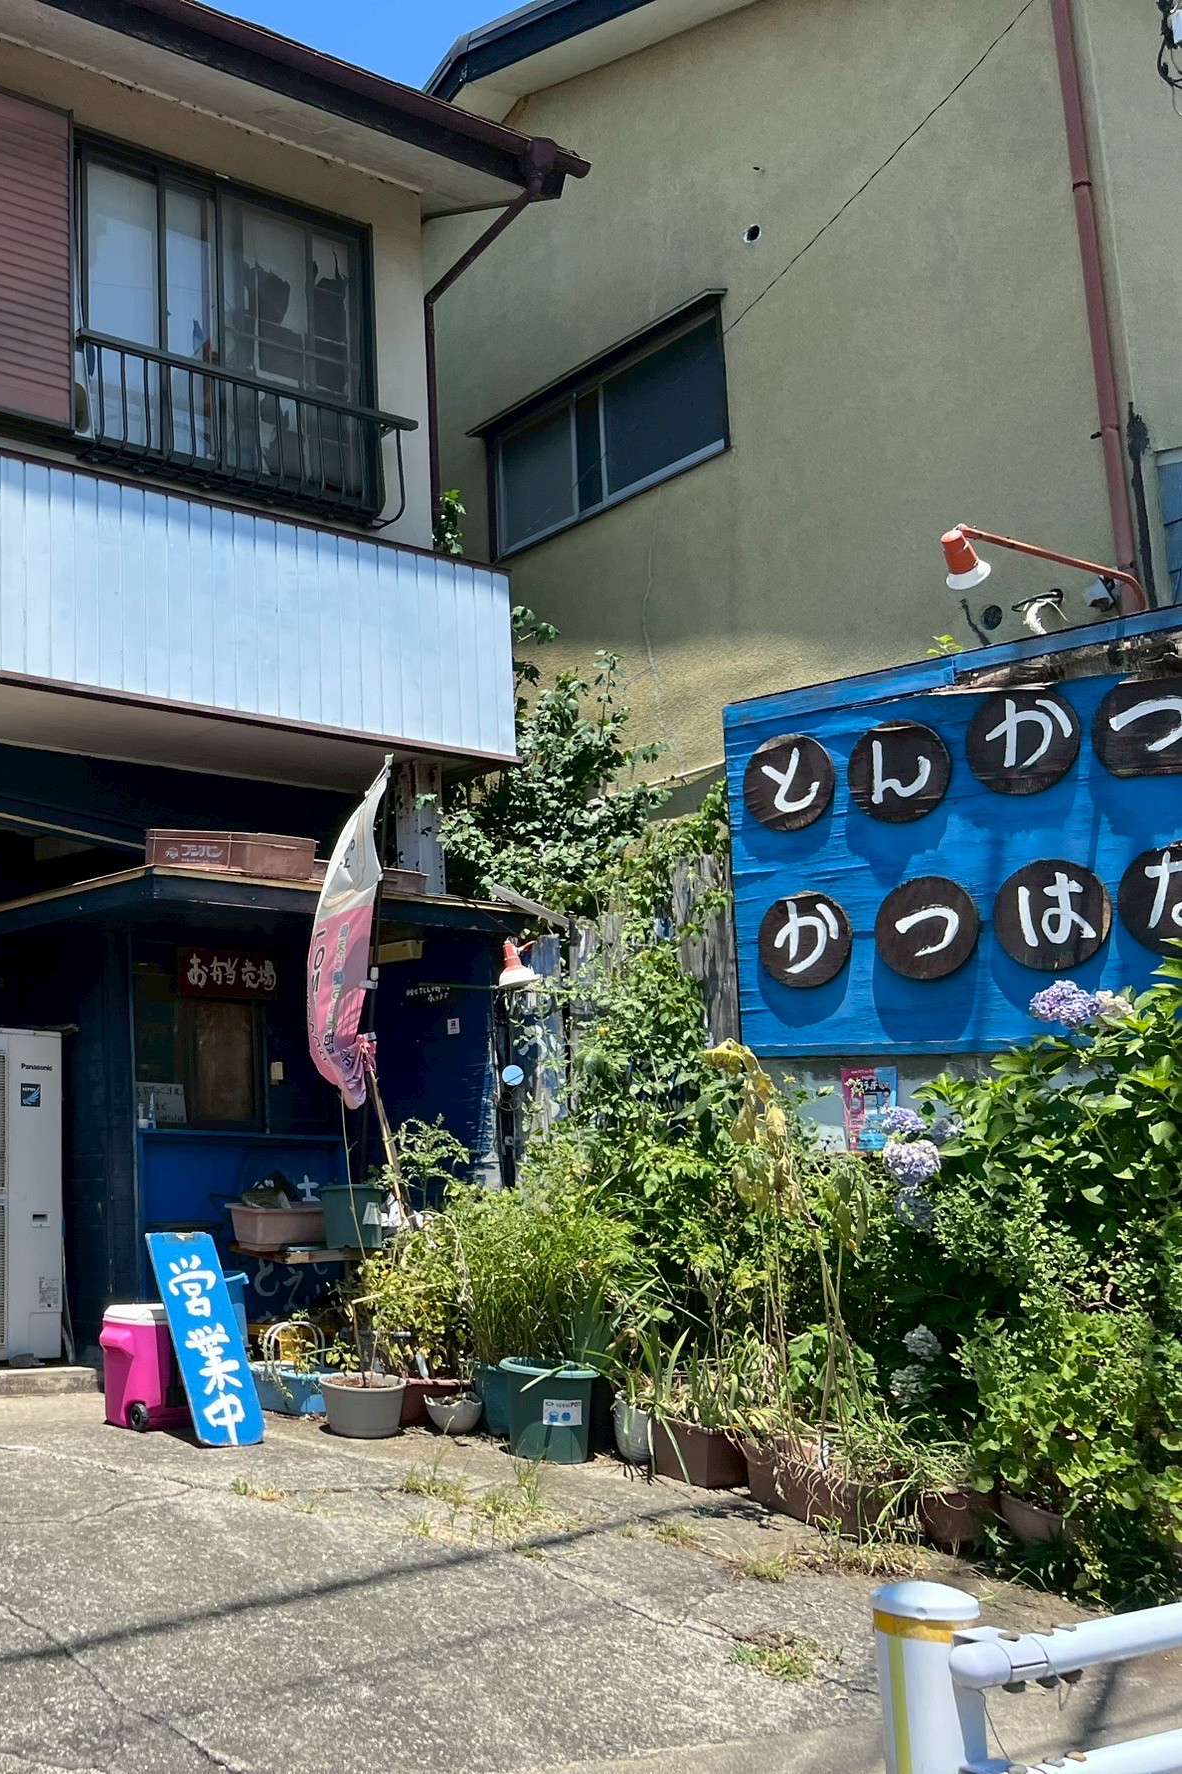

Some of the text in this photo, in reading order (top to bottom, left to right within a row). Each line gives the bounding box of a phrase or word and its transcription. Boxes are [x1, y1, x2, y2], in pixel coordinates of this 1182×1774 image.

[761, 696, 1182, 813] とんかつ
[21, 1062, 54, 1072] Panasonic
[168, 1254, 246, 1446] 営業中
